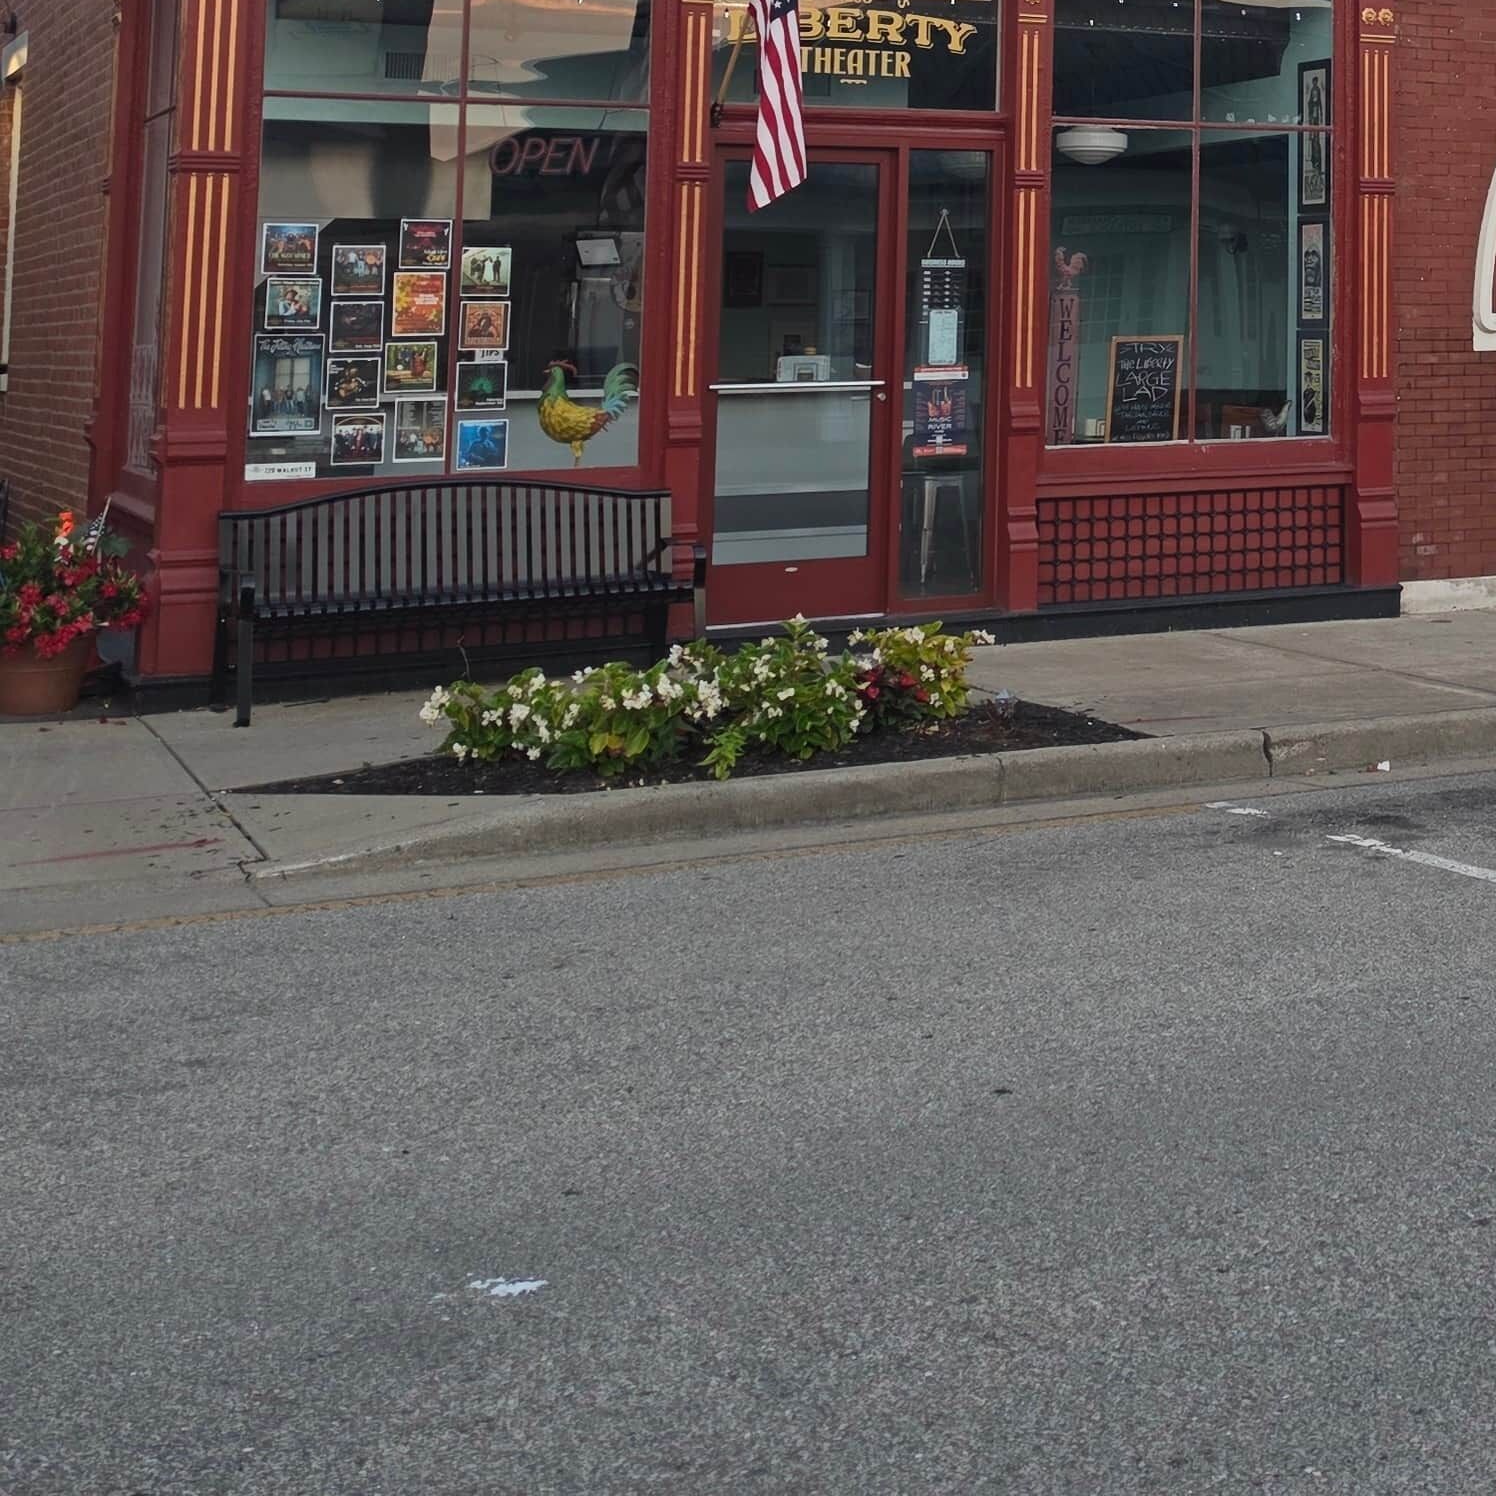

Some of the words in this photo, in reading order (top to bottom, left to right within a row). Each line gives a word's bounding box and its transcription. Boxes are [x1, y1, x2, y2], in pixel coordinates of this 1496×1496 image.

[727, 6, 977, 54] LBERTY
[800, 45, 911, 78] THEATER
[489, 137, 600, 175] OPEN
[1053, 298, 1074, 444] WELCOME
[1115, 370, 1171, 387] LARGE
[1121, 385, 1169, 402] LAD
